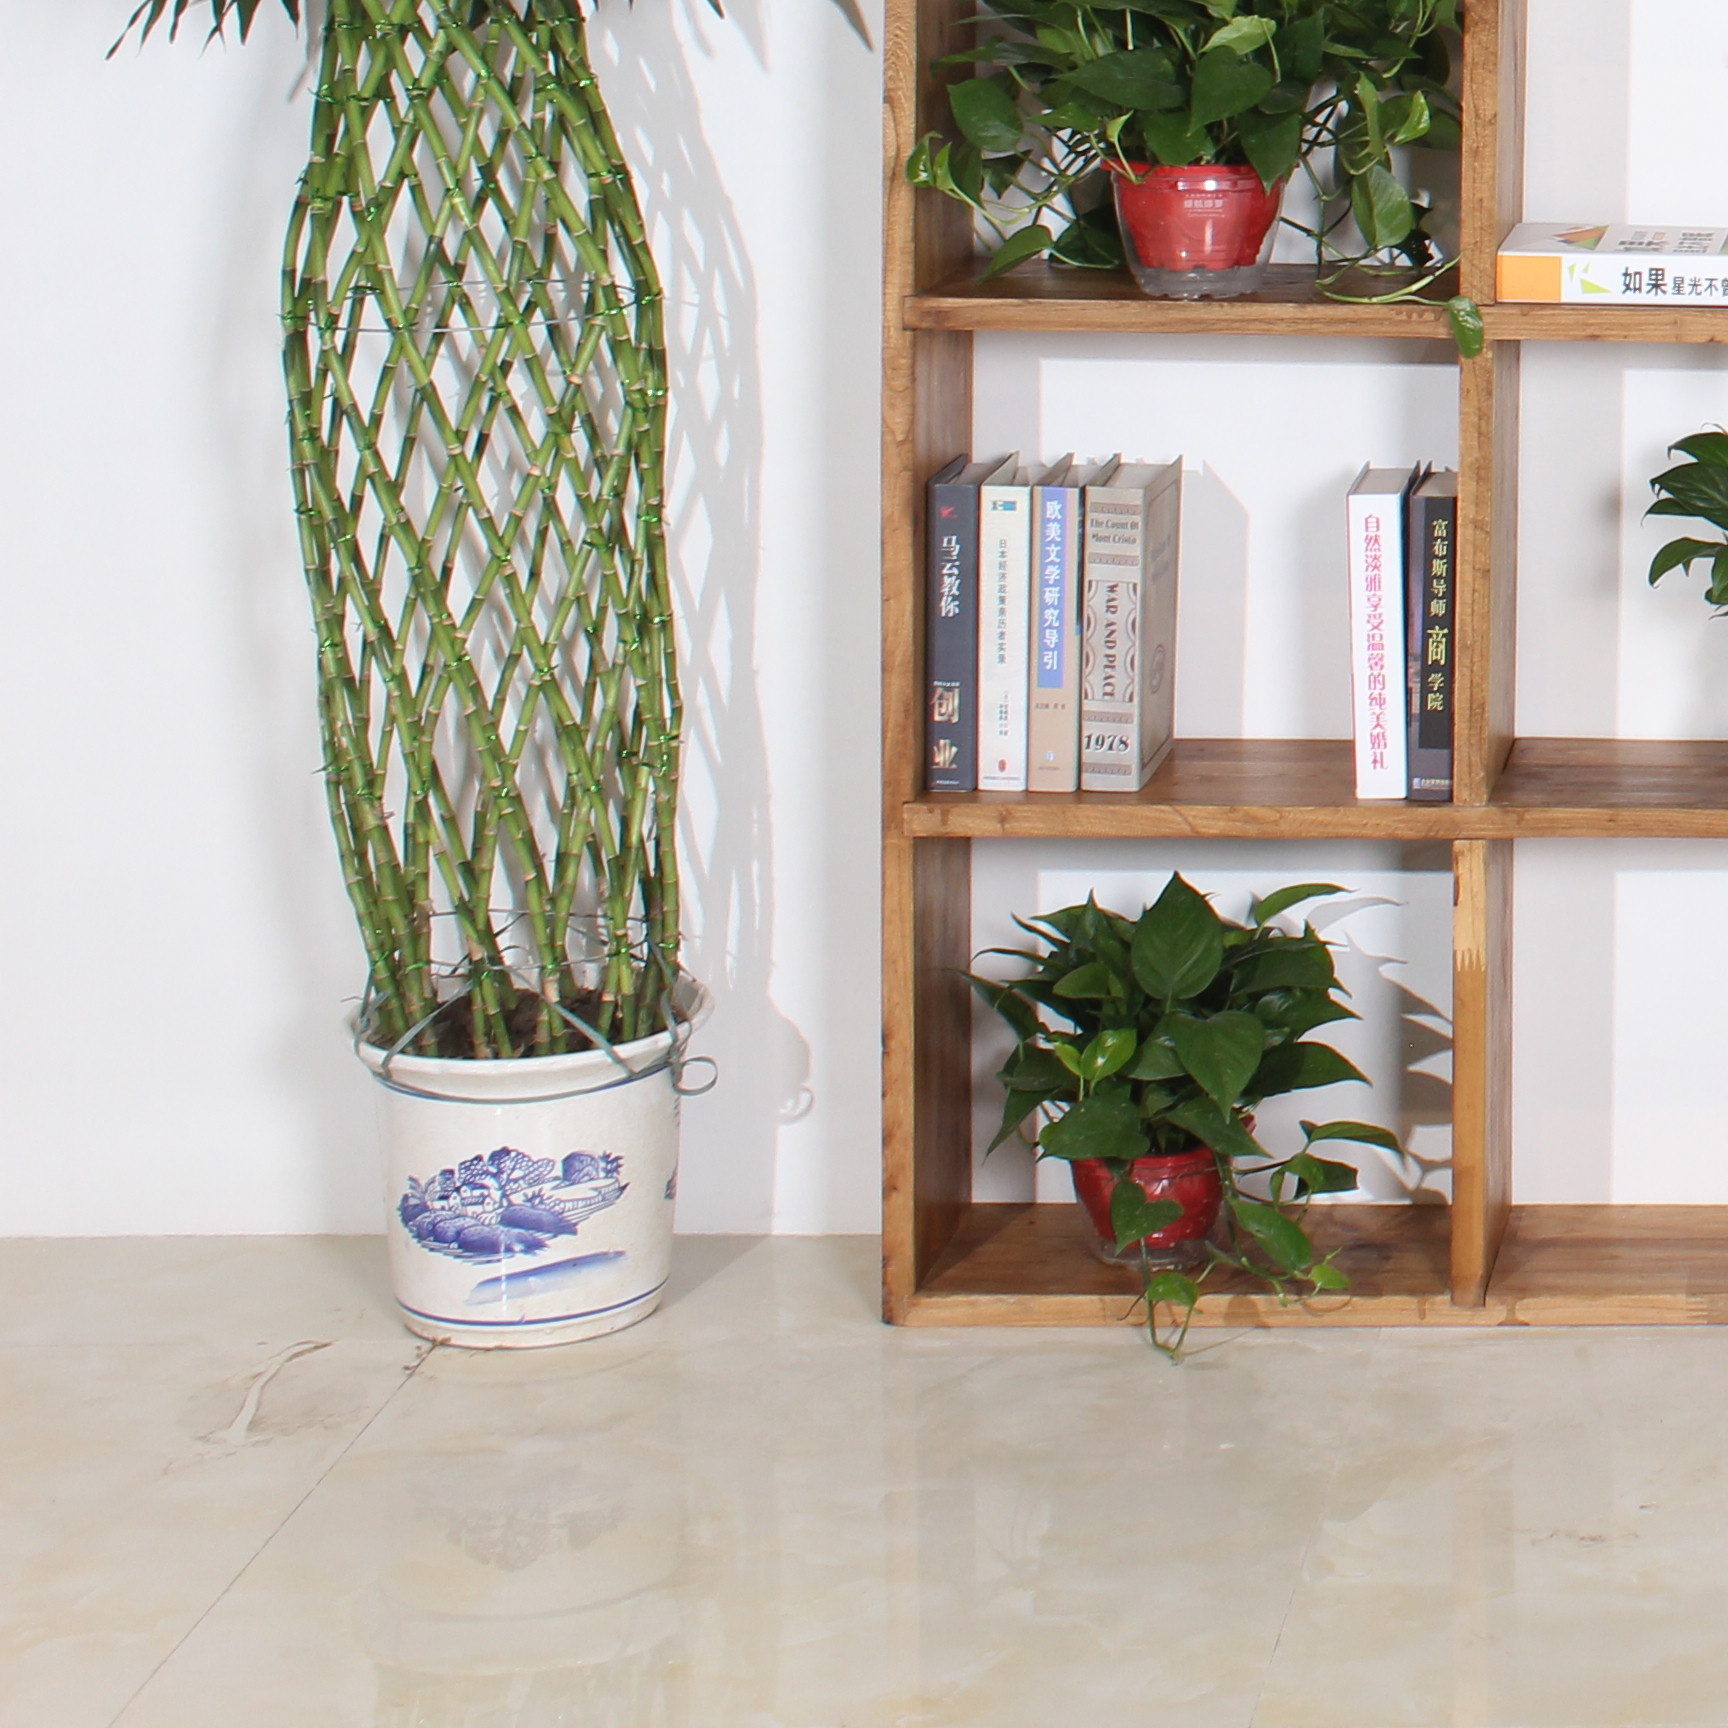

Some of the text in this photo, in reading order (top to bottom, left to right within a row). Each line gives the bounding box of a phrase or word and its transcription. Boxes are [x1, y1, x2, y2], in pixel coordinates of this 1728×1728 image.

[1622, 267, 1667, 296] 如果
[1090, 518, 1104, 529] The
[1043, 500, 1062, 671] 欧美文学研究导引
[1105, 583, 1119, 615] WAR
[1427, 518, 1449, 712] 富布斯导师 商学院
[1104, 618, 1118, 649] AND
[1364, 514, 1388, 771] 自然淡雅享受温馨的纯美婚礼
[930, 535, 960, 769] 马云教你 创业
[1084, 733, 1130, 753] 1978
